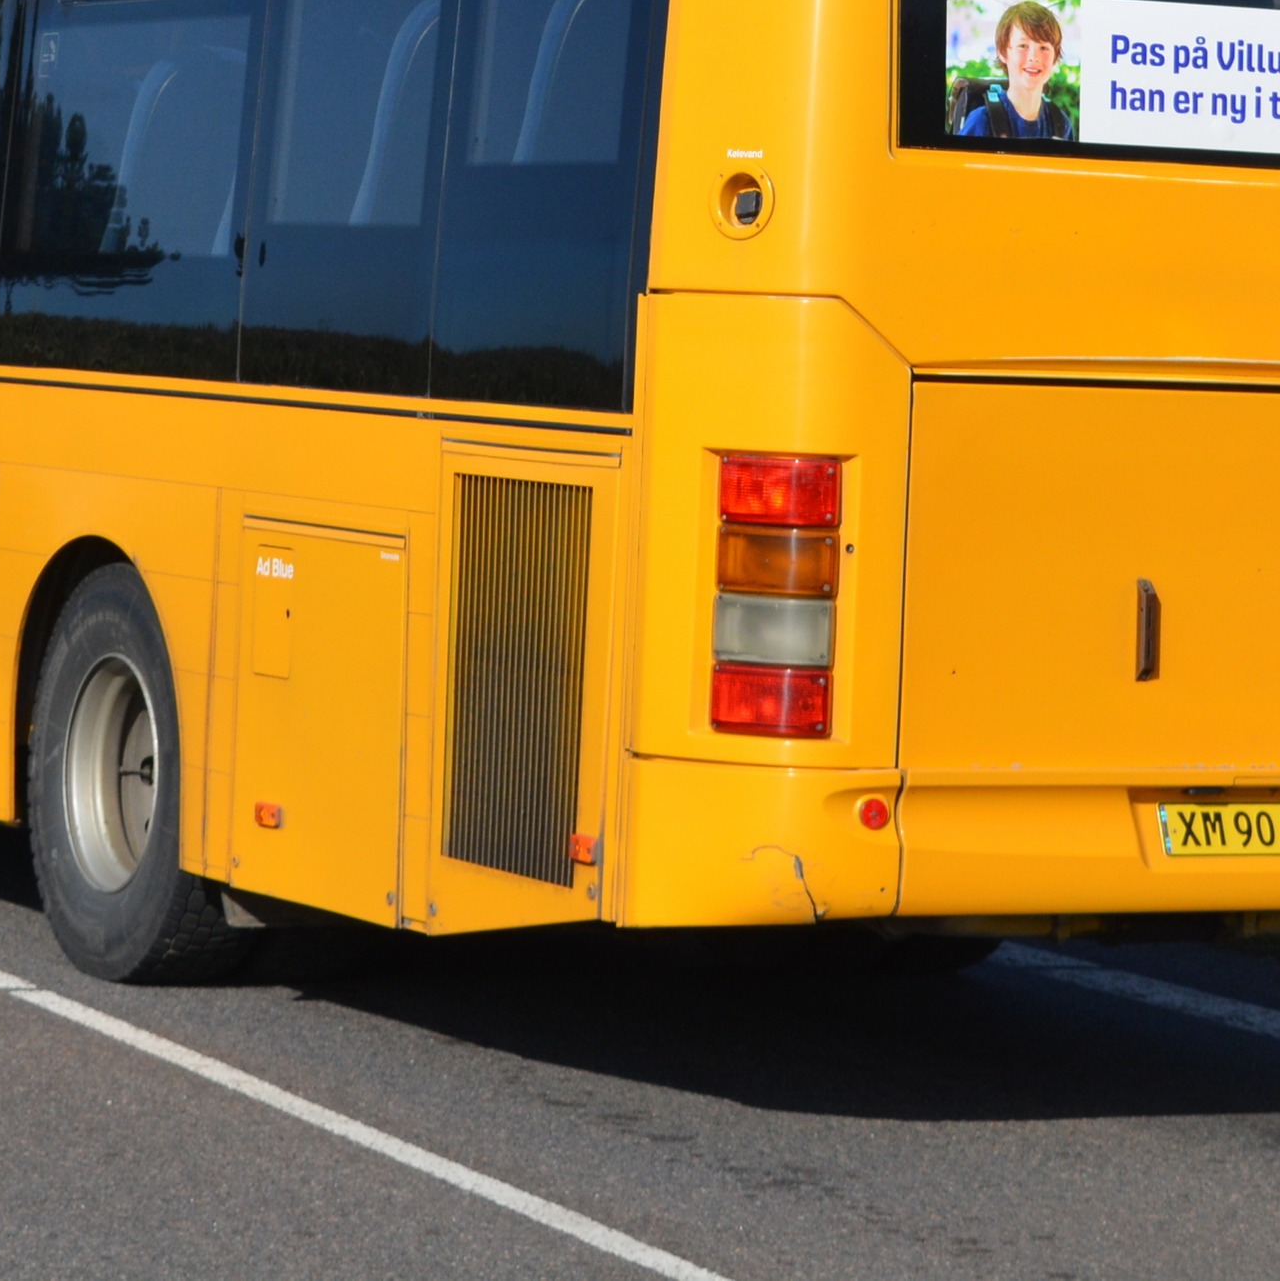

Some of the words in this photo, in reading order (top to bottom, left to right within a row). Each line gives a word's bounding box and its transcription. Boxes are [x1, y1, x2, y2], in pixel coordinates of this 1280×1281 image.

[1111, 34, 1165, 67] Pas
[1173, 36, 1208, 74] på
[1110, 80, 1165, 113] han
[1173, 89, 1204, 115] er
[1211, 92, 1246, 124] ny
[1255, 86, 1262, 118] i
[256, 556, 270, 576] Ad
[272, 557, 294, 579] Blue
[1177, 811, 1226, 847] XM
[1234, 811, 1275, 847] 90
